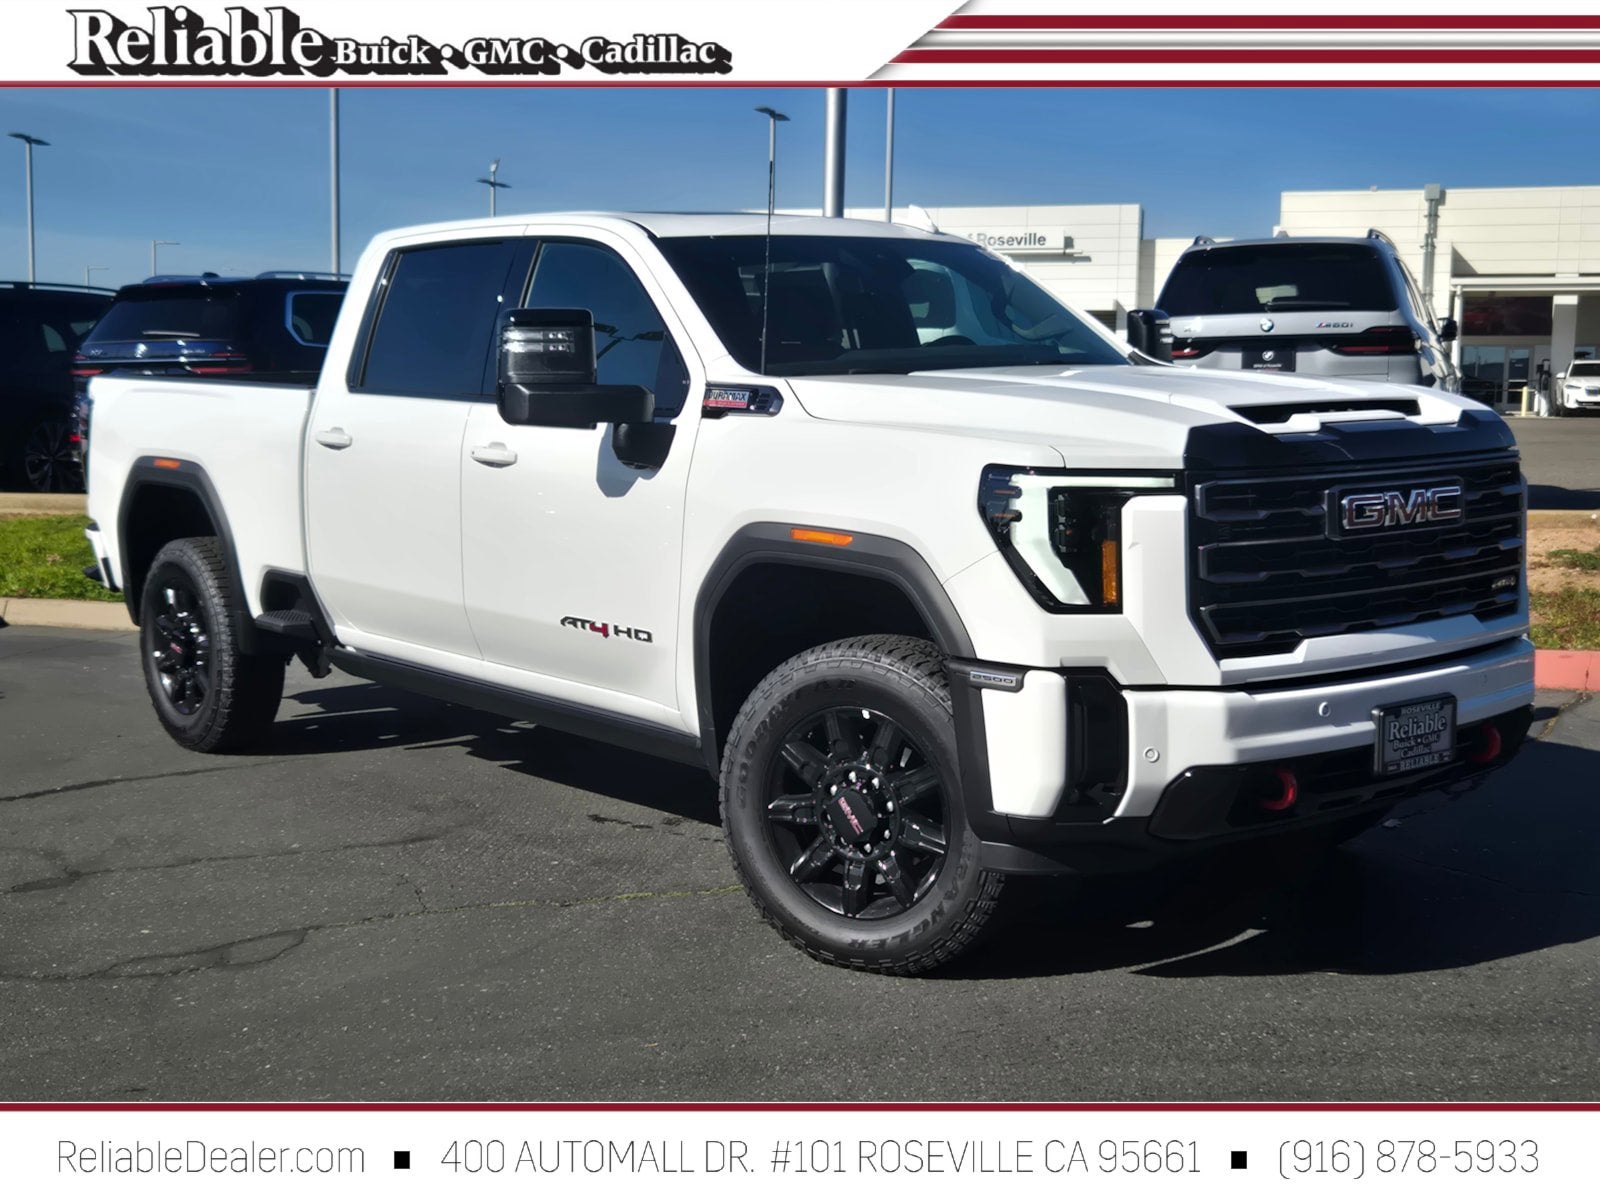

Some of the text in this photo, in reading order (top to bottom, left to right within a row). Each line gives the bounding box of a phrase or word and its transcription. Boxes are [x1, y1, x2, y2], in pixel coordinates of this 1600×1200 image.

[976, 232, 1047, 247] Roseville
[1340, 486, 1462, 530] GMC
[560, 616, 653, 643] AT4 HD
[971, 673, 1014, 684] 2500
[1389, 712, 1447, 740] Reliable
